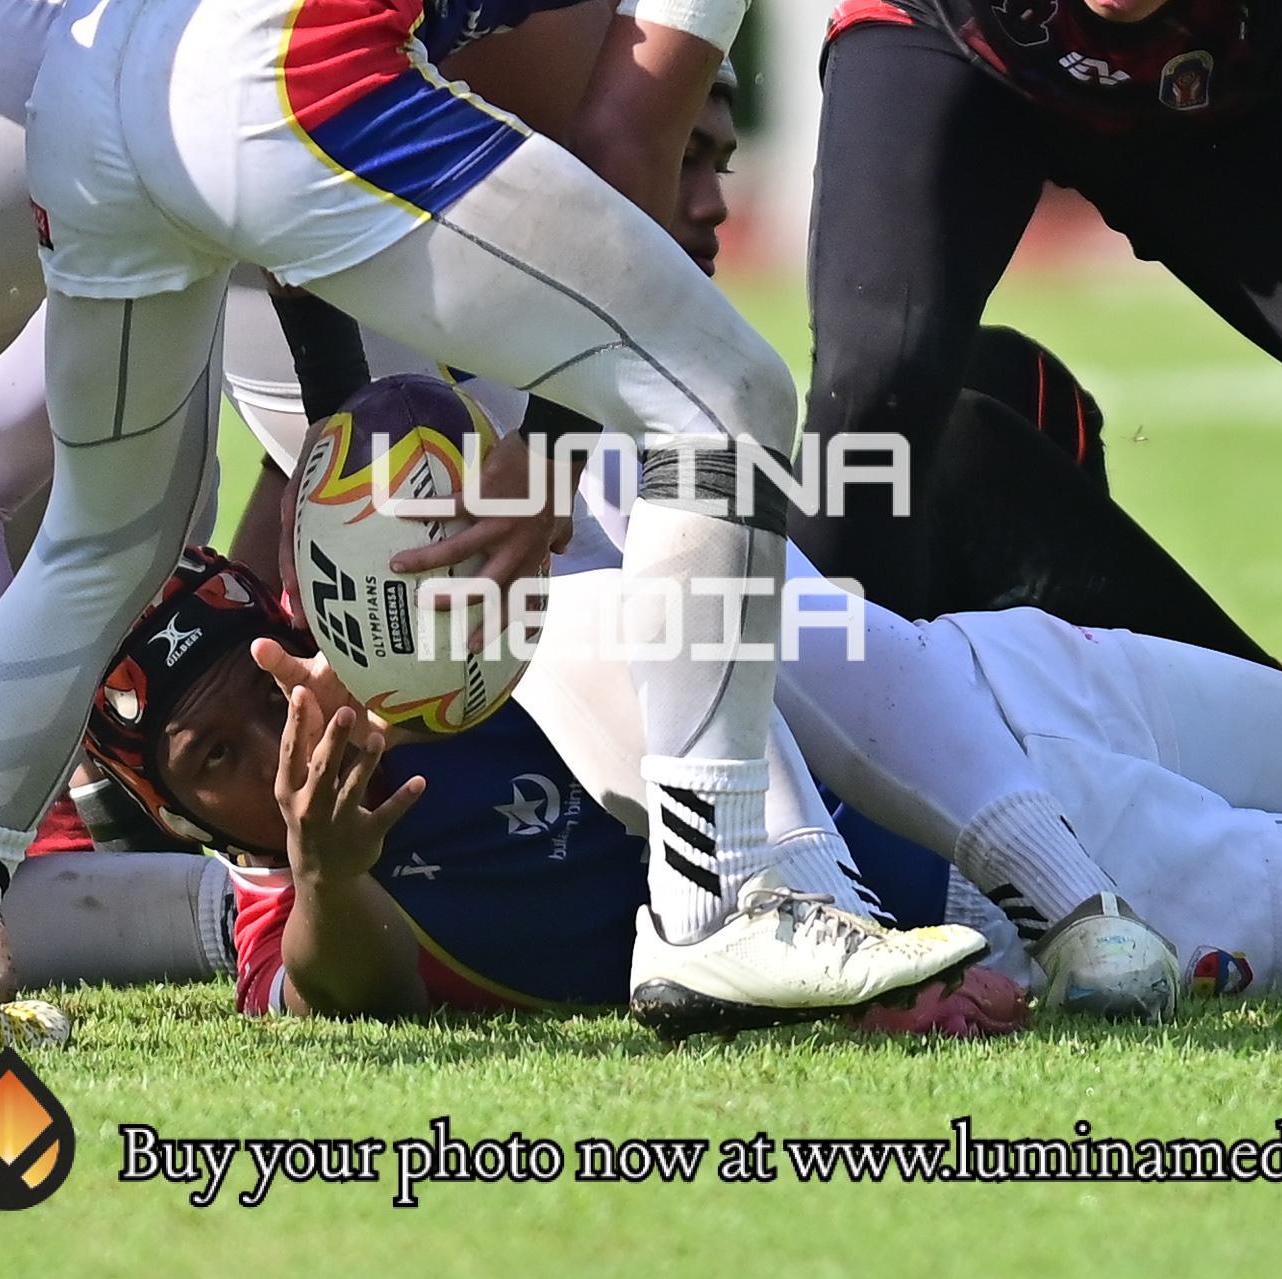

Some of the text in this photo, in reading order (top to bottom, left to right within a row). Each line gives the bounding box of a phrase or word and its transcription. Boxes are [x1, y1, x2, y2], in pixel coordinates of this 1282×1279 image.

[365, 575, 386, 658] OLYMPIANS
[386, 585, 404, 651] AEROSENSA
[166, 628, 203, 667] GILBERT
[547, 820, 579, 860] buln
